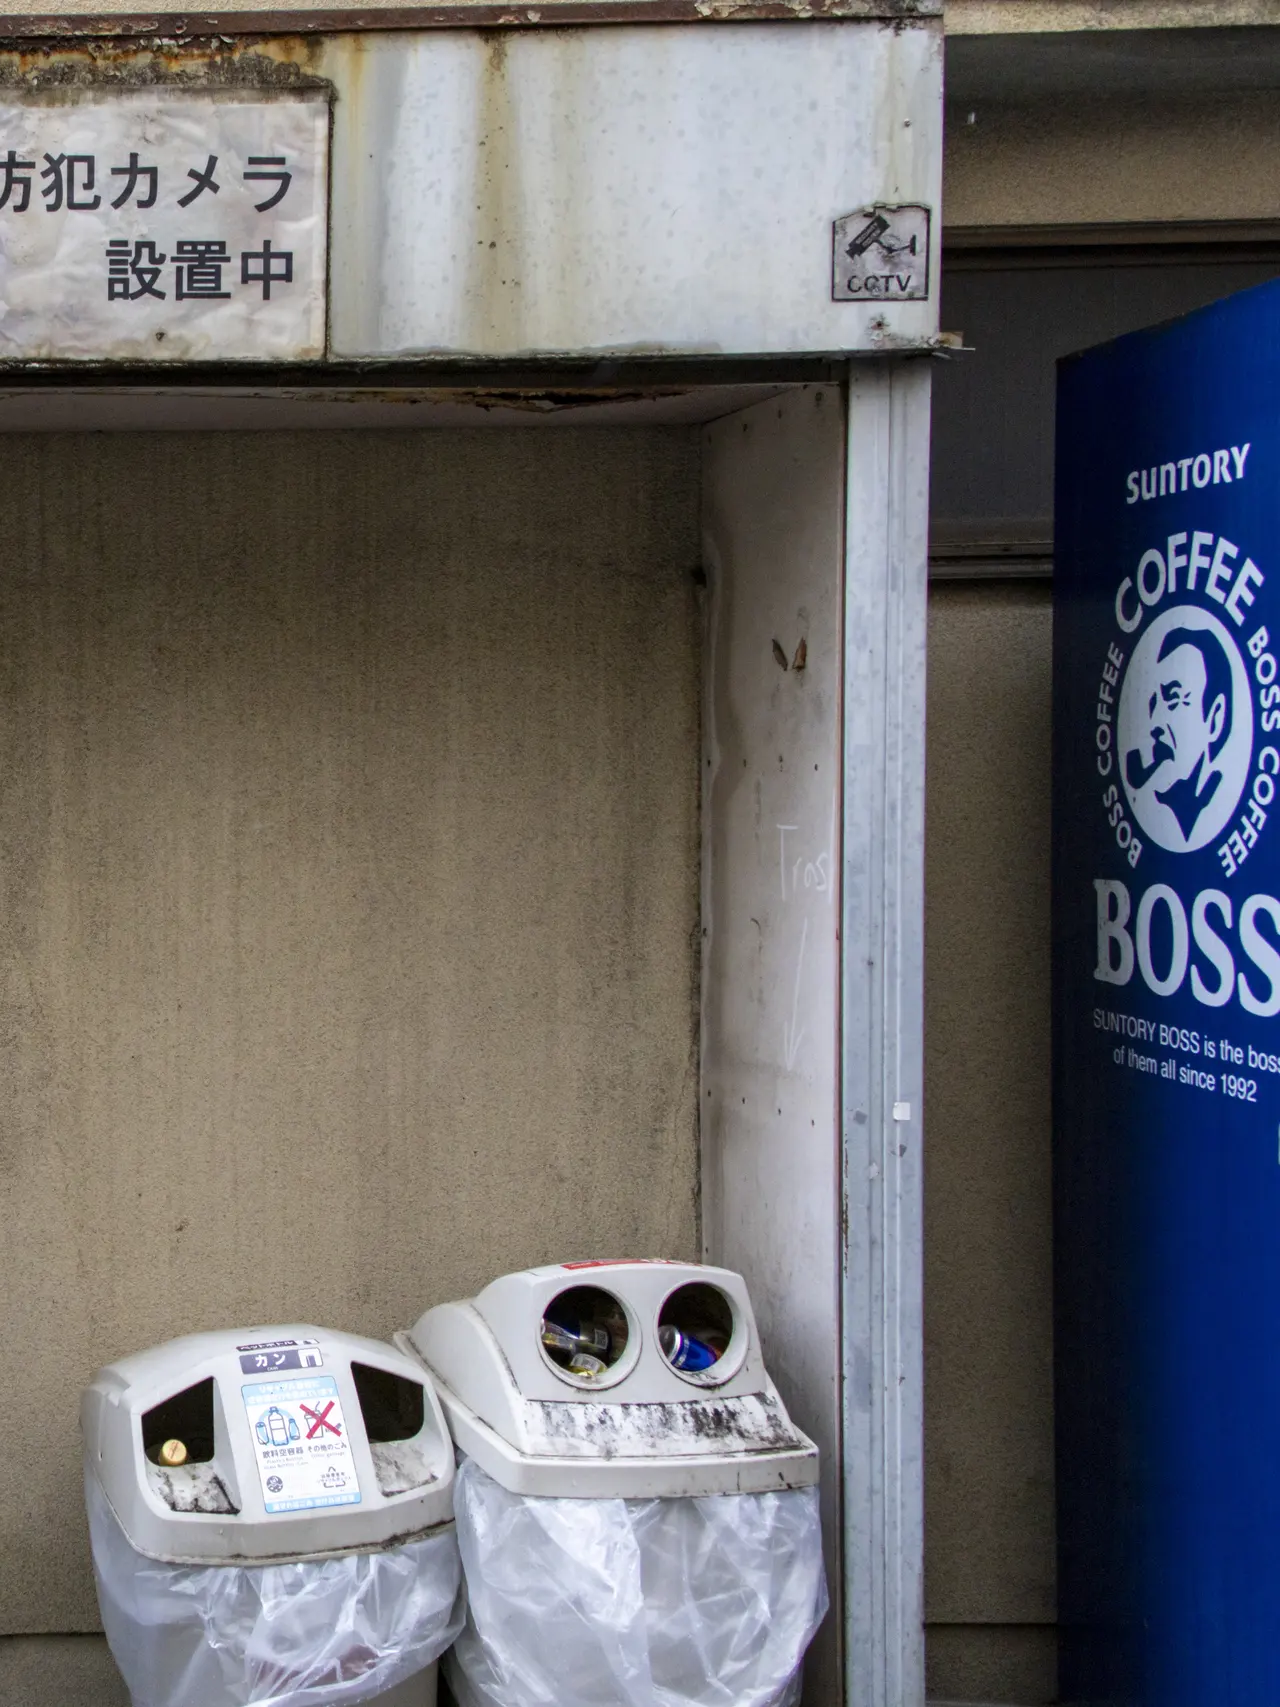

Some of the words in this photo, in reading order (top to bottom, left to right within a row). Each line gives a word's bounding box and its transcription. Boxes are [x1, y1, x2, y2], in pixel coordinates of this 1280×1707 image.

[106, 239, 294, 301] 設置中
[847, 274, 912, 294] CCTV
[1126, 442, 1251, 504] SUNTORY
[1115, 530, 1265, 633] COFFEE
[1096, 641, 1125, 776] COFFEE
[1247, 625, 1280, 732] BOSS
[1103, 784, 1143, 868] BOSS
[1217, 746, 1280, 878] COFFEE
[1093, 878, 1280, 1017] BOSS
[1093, 1008, 1156, 1042] SUNTORY
[1159, 1024, 1200, 1054] BOSS
[1203, 1035, 1216, 1058] is
[1219, 1040, 1244, 1065] the
[1113, 1046, 1126, 1064] of
[1128, 1048, 1157, 1074] them
[1160, 1059, 1176, 1080] all
[1179, 1064, 1215, 1091] since
[1220, 1074, 1257, 1102] 1992
[255, 1354, 286, 1368] カン
[262, 1446, 304, 1459] 飲料空容器
